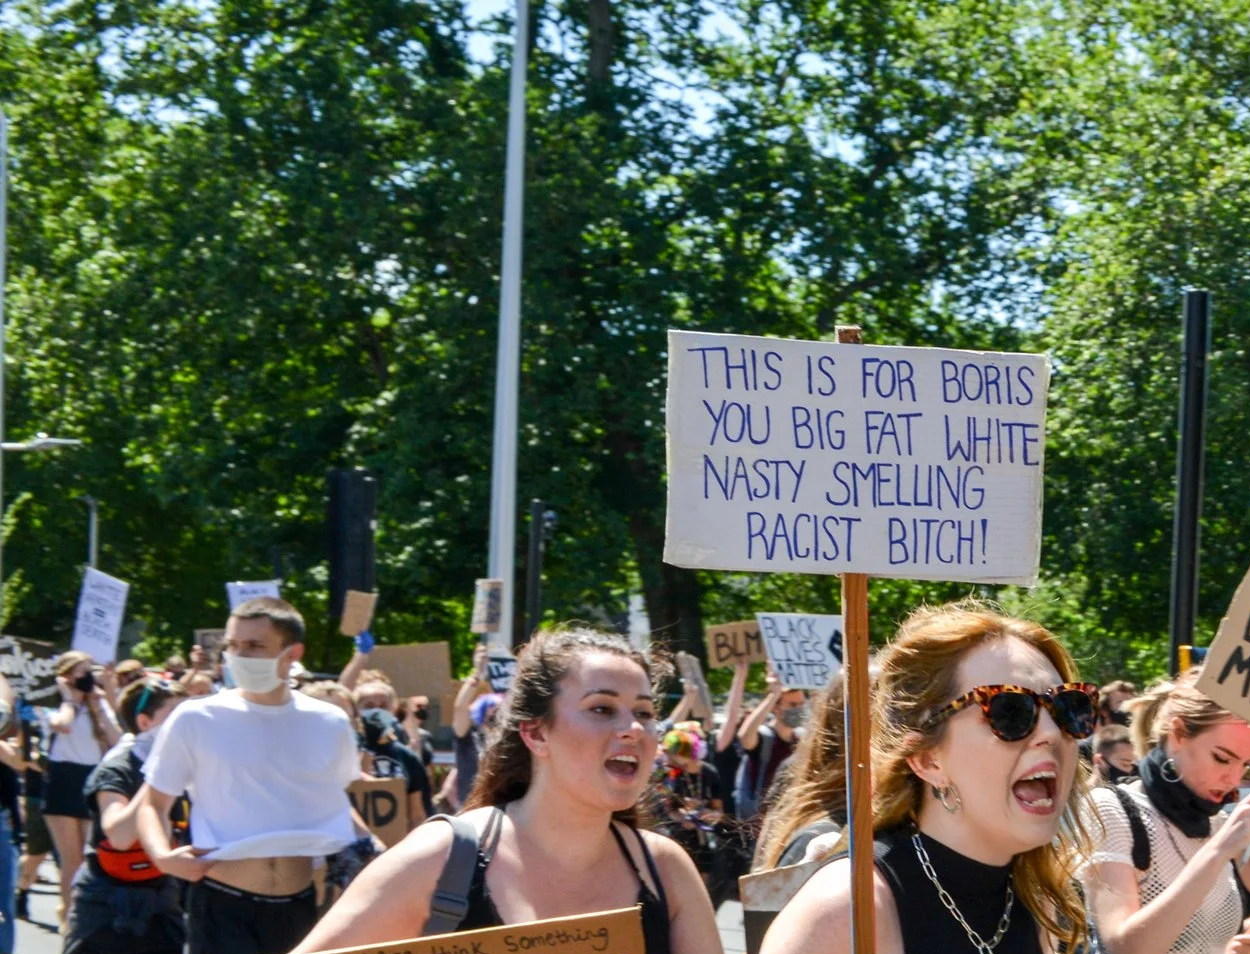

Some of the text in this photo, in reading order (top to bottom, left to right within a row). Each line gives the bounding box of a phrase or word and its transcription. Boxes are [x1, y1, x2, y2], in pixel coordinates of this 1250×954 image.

[687, 346, 1034, 406] THIS IS FOR BORIS
[702, 400, 1039, 466] YOU BIG FAT WHITE
[703, 454, 985, 510] NASTY SMELLING
[747, 512, 988, 565] RACIST BITCH!
[715, 631, 762, 662] BLM
[761, 616, 823, 640] BLACK
[769, 640, 827, 663] LIVES
